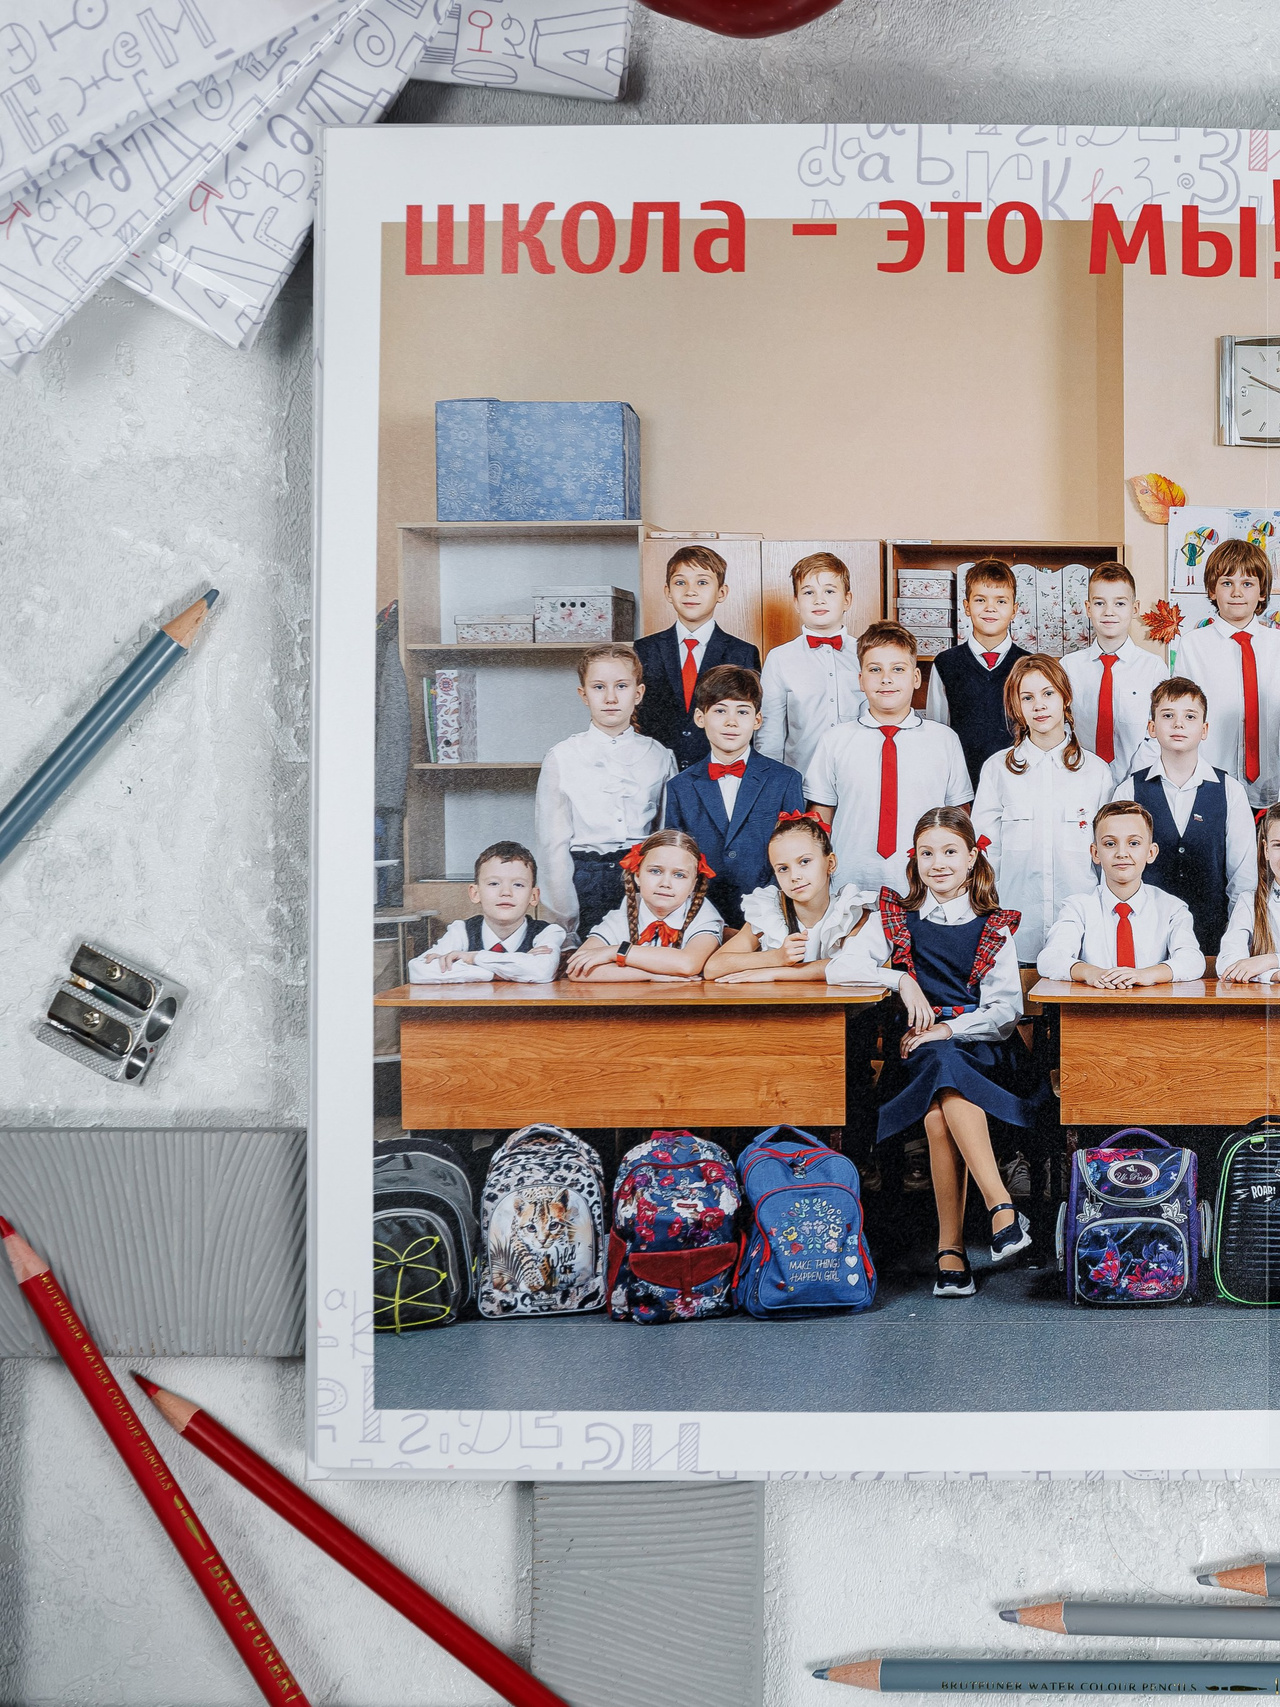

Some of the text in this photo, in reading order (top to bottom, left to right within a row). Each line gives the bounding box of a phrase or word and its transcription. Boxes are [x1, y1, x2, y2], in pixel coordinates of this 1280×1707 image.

[405, 200, 748, 275] школа
[876, 200, 1042, 274] это
[1250, 1185, 1276, 1199] ROAR!
[789, 1260, 812, 1270] MAKE
[39, 1272, 173, 1492] RUTFUNER WATER COLOUR PENCILS
[941, 1680, 1198, 1693] BRUTFUNER WATER COLOUR PENCILS
